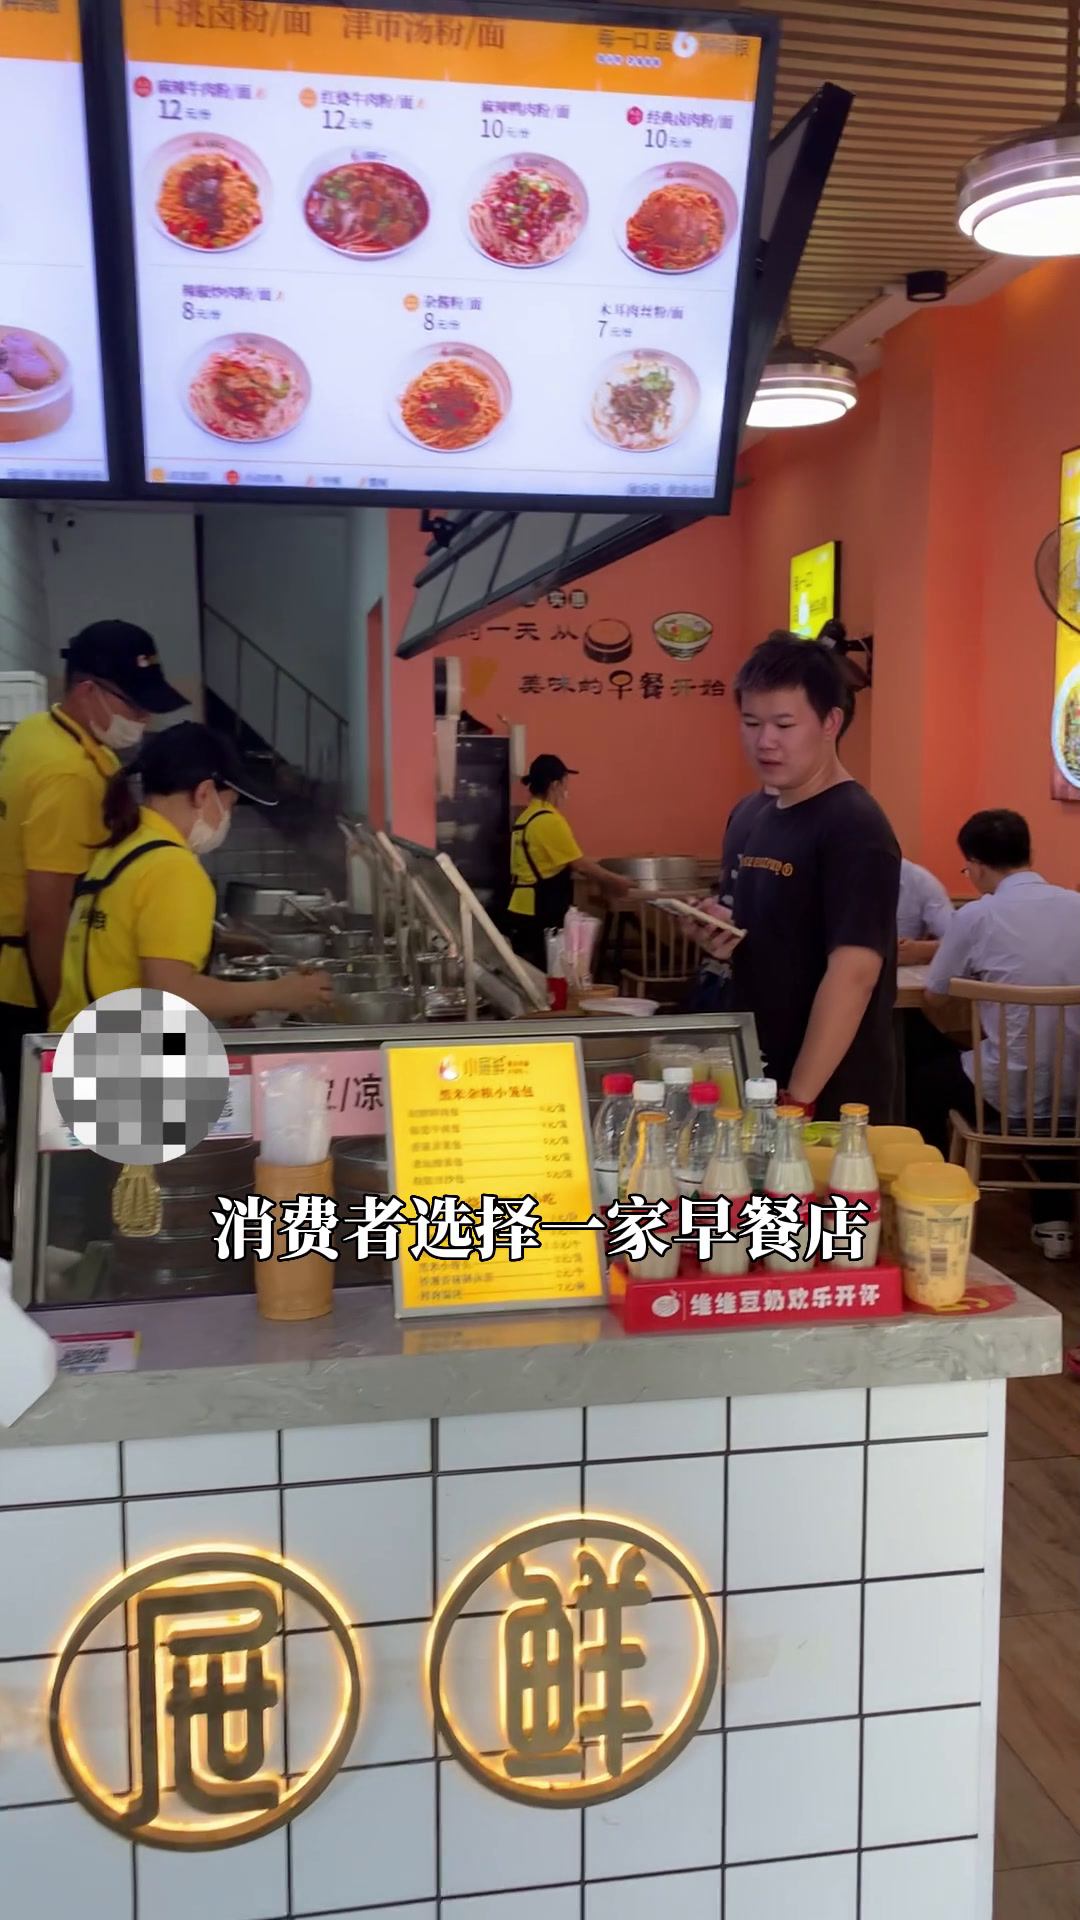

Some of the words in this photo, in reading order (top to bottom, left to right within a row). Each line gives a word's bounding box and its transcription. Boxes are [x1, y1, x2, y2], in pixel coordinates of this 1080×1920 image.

[342, 10, 505, 50] 津市汤粉/面
[320, 90, 414, 109] 红烧牛肉粉/面
[646, 110, 734, 130] 经典卤肉粉/面
[601, 302, 684, 320] 木耳肉丝粉/面
[518, 670, 727, 700] 美味的早餐开始
[689, 1283, 881, 1317] 维维豆奶欢乐开杯
